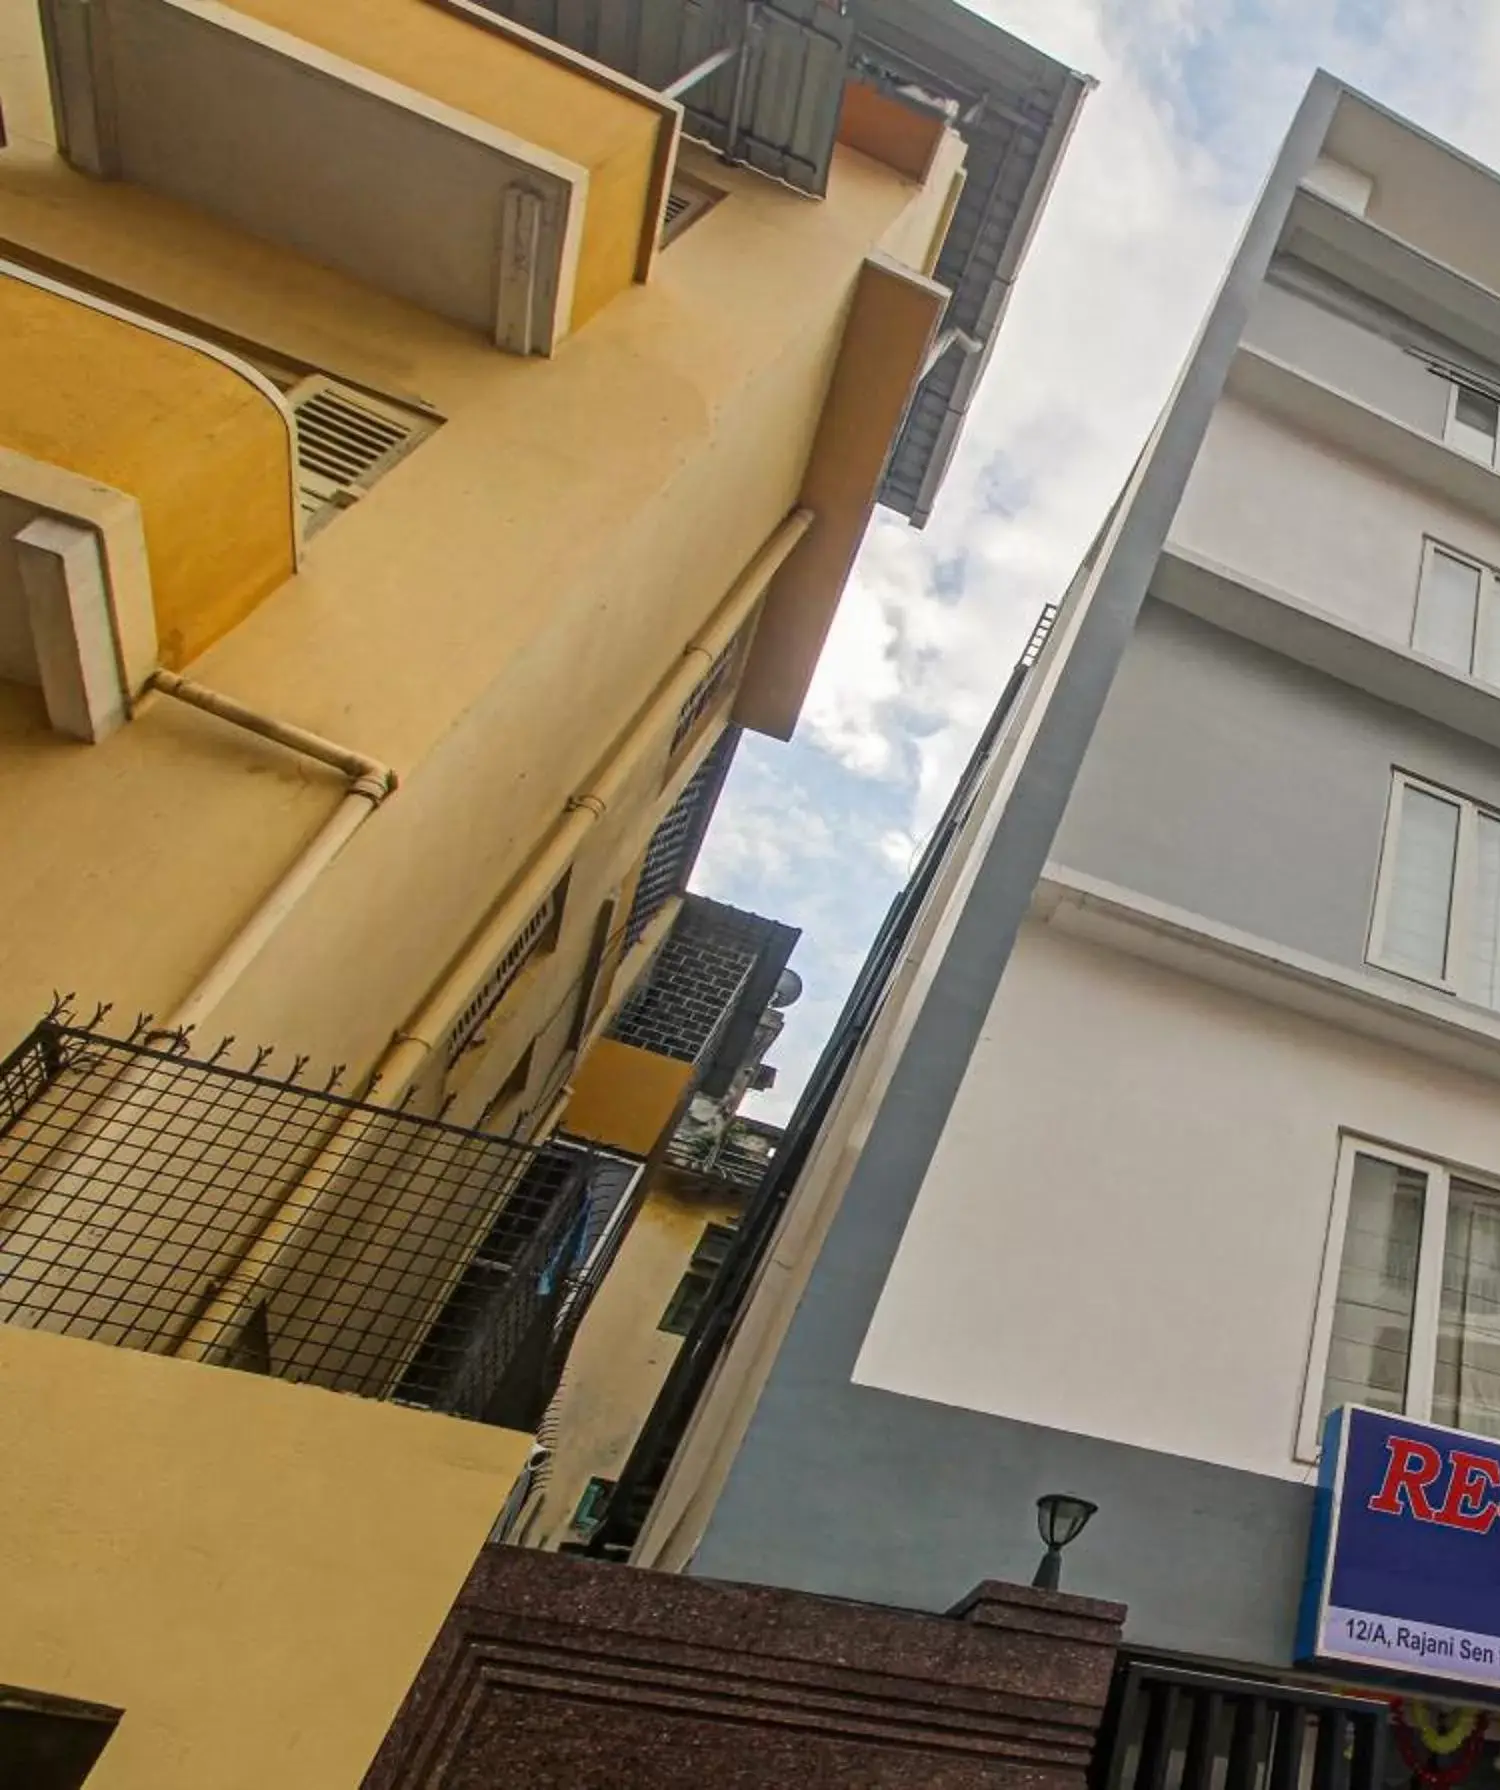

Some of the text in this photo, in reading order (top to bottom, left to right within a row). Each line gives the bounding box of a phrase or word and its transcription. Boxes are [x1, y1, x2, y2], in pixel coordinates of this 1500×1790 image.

[1346, 1618, 1392, 1648] 12/A,
[1397, 1627, 1454, 1657] Rajani
[1459, 1638, 1494, 1664] Sen
